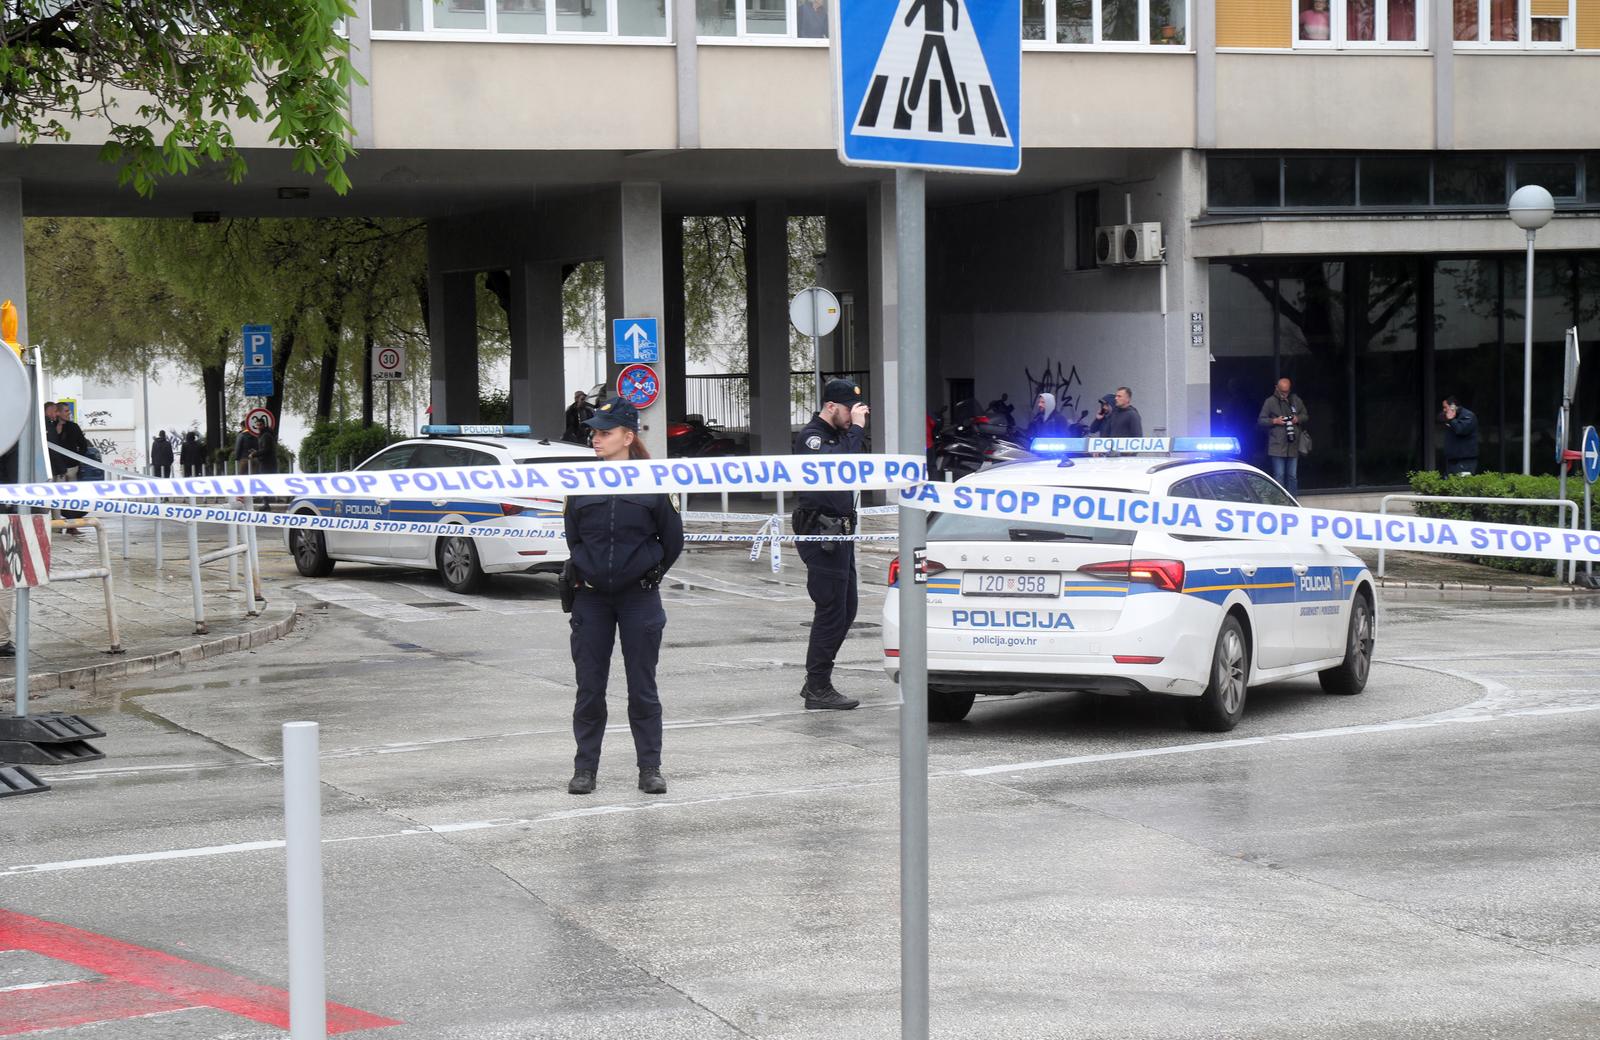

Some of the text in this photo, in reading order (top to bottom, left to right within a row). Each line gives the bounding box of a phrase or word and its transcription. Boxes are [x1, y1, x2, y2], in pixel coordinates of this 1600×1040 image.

[252, 335, 264, 352] P
[383, 354, 395, 364] 30
[464, 426, 501, 434] POLICIJA
[1093, 438, 1165, 450] POLICIJA
[92, 479, 273, 496] POLICIJA
[284, 475, 377, 495] STOP
[389, 468, 549, 492] POLICIJA
[557, 466, 641, 489] STOP
[650, 461, 792, 486] POLICIJA
[801, 460, 875, 484] STOP
[345, 504, 383, 515] POLICIJA
[51, 499, 90, 511] STOP
[94, 501, 160, 516] POLICIJA
[165, 507, 202, 520] STOP
[206, 511, 268, 525] POLICIJA
[272, 515, 308, 527] STOP
[311, 517, 369, 530] POLICIJA
[373, 522, 407, 533] STOP
[410, 524, 465, 535] POLICIJA
[469, 527, 500, 537] STOP
[503, 529, 555, 538] POLICIJA
[954, 486, 1040, 514] STOP
[1051, 494, 1202, 528] POLICIJA
[1215, 508, 1299, 536] STOP
[1311, 515, 1458, 545] POLICIJA
[1470, 527, 1551, 552] STOP
[1562, 533, 1600, 554] PO
[979, 575, 1046, 592] 120 958
[1300, 576, 1331, 591] POLICIJA
[952, 610, 1075, 629] POLICIJA
[973, 635, 1037, 647] policija.gov.hr
